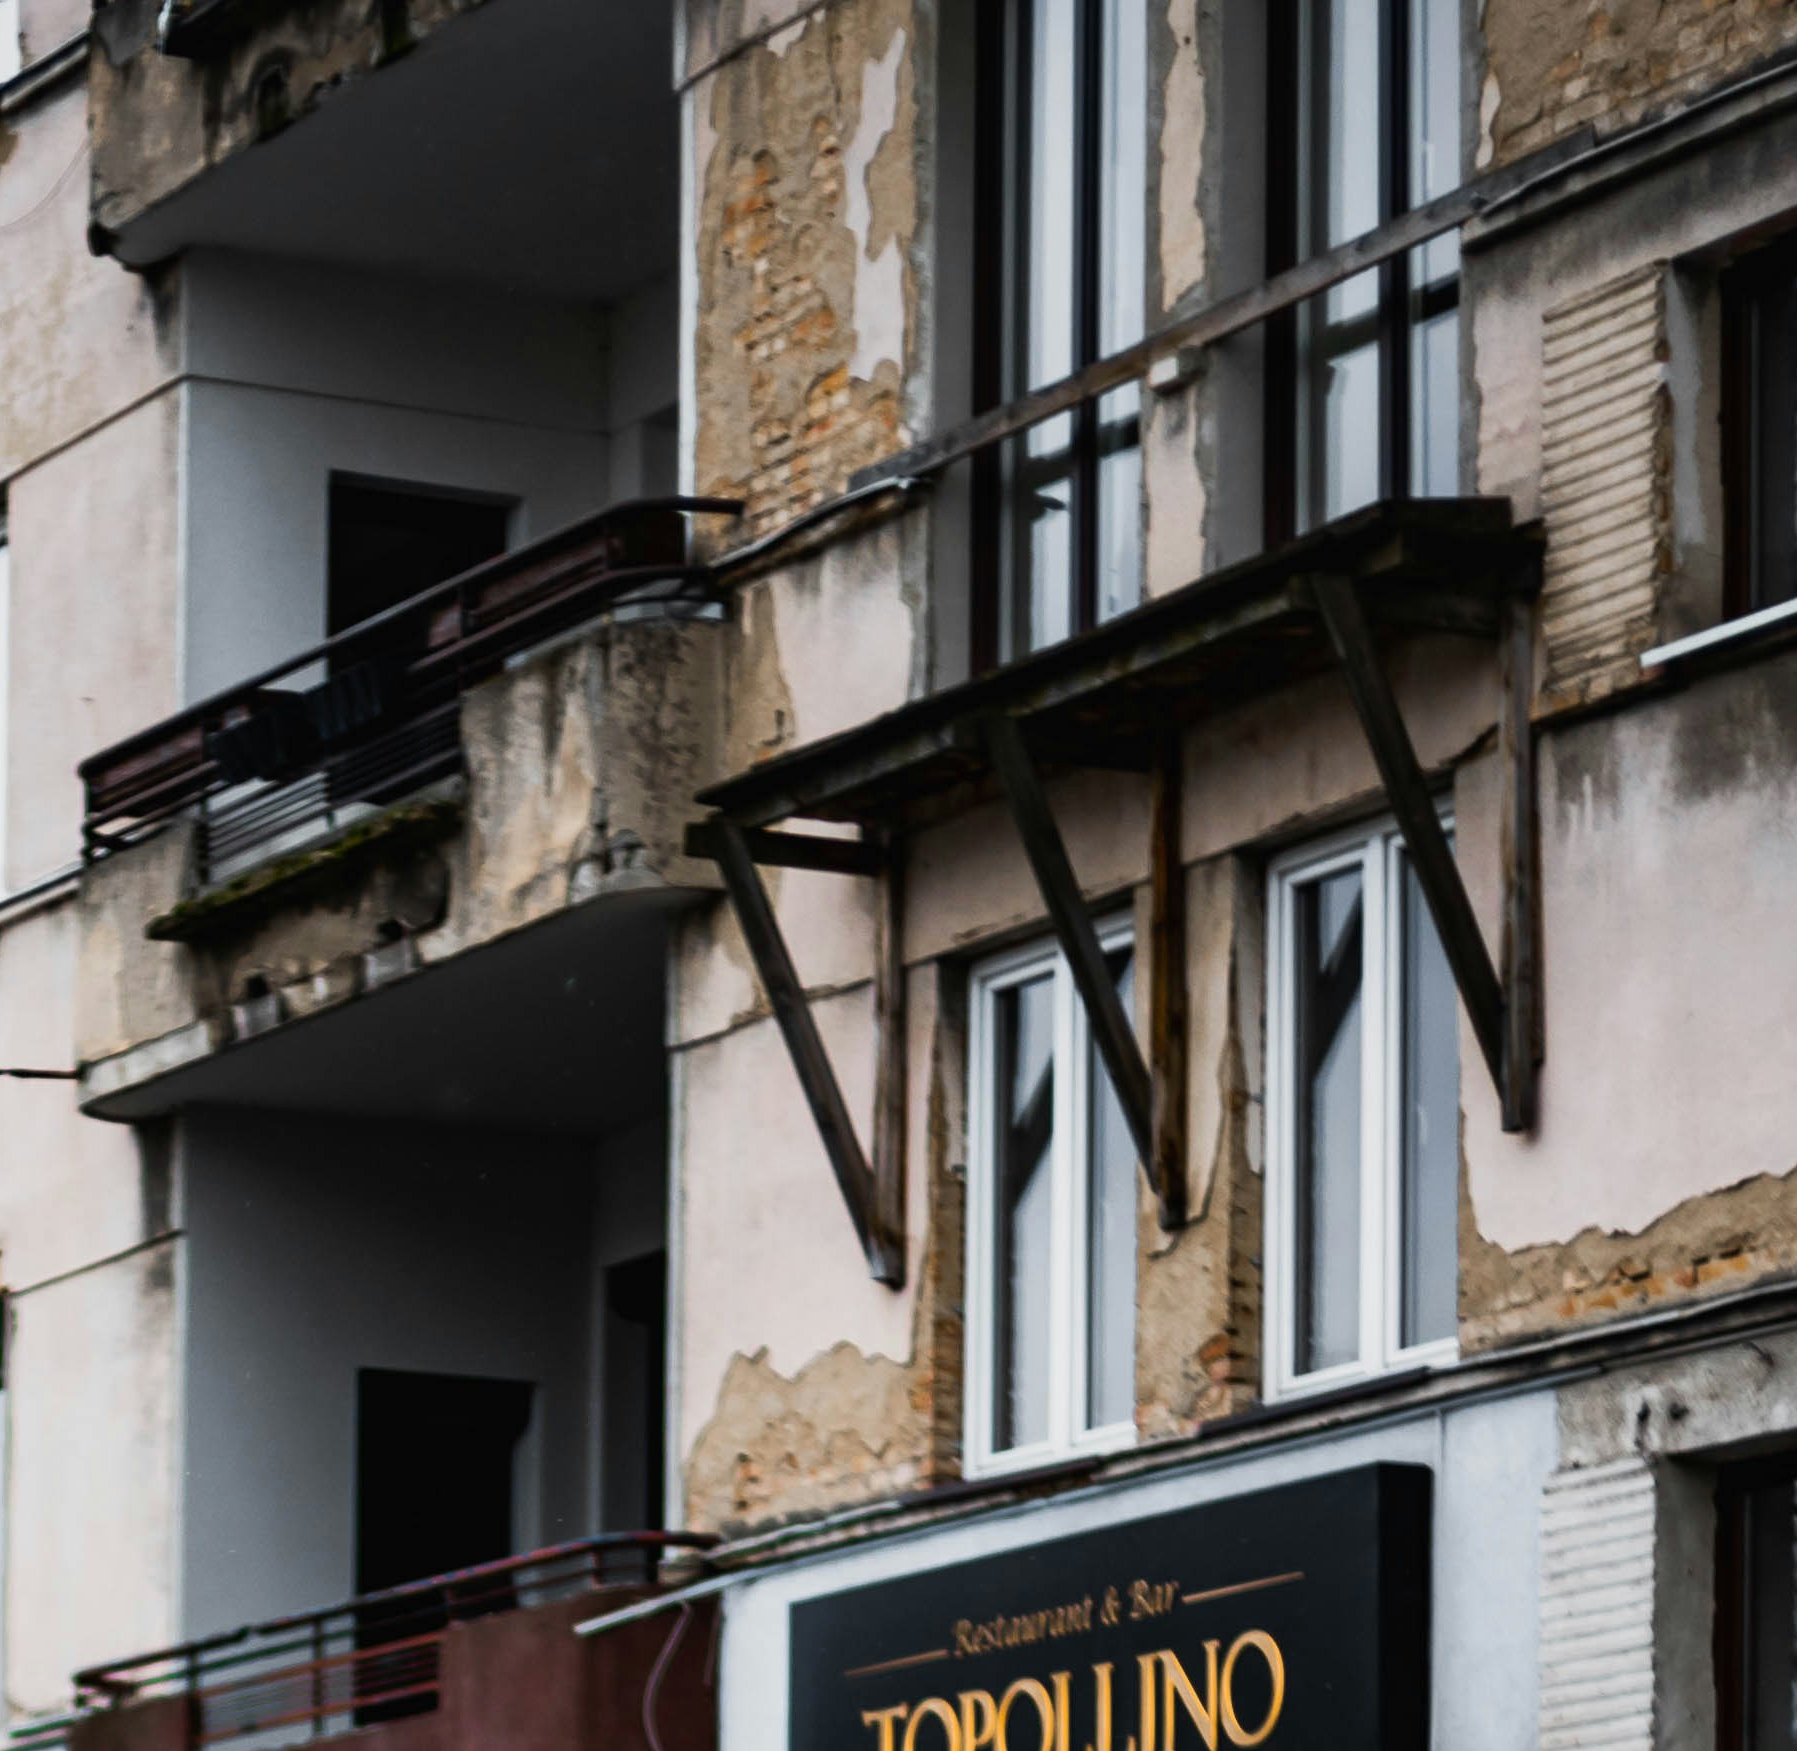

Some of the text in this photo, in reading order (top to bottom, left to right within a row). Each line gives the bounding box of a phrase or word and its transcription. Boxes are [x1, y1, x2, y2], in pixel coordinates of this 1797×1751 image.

[953, 1579, 1180, 1659] Restaurant & Bar
